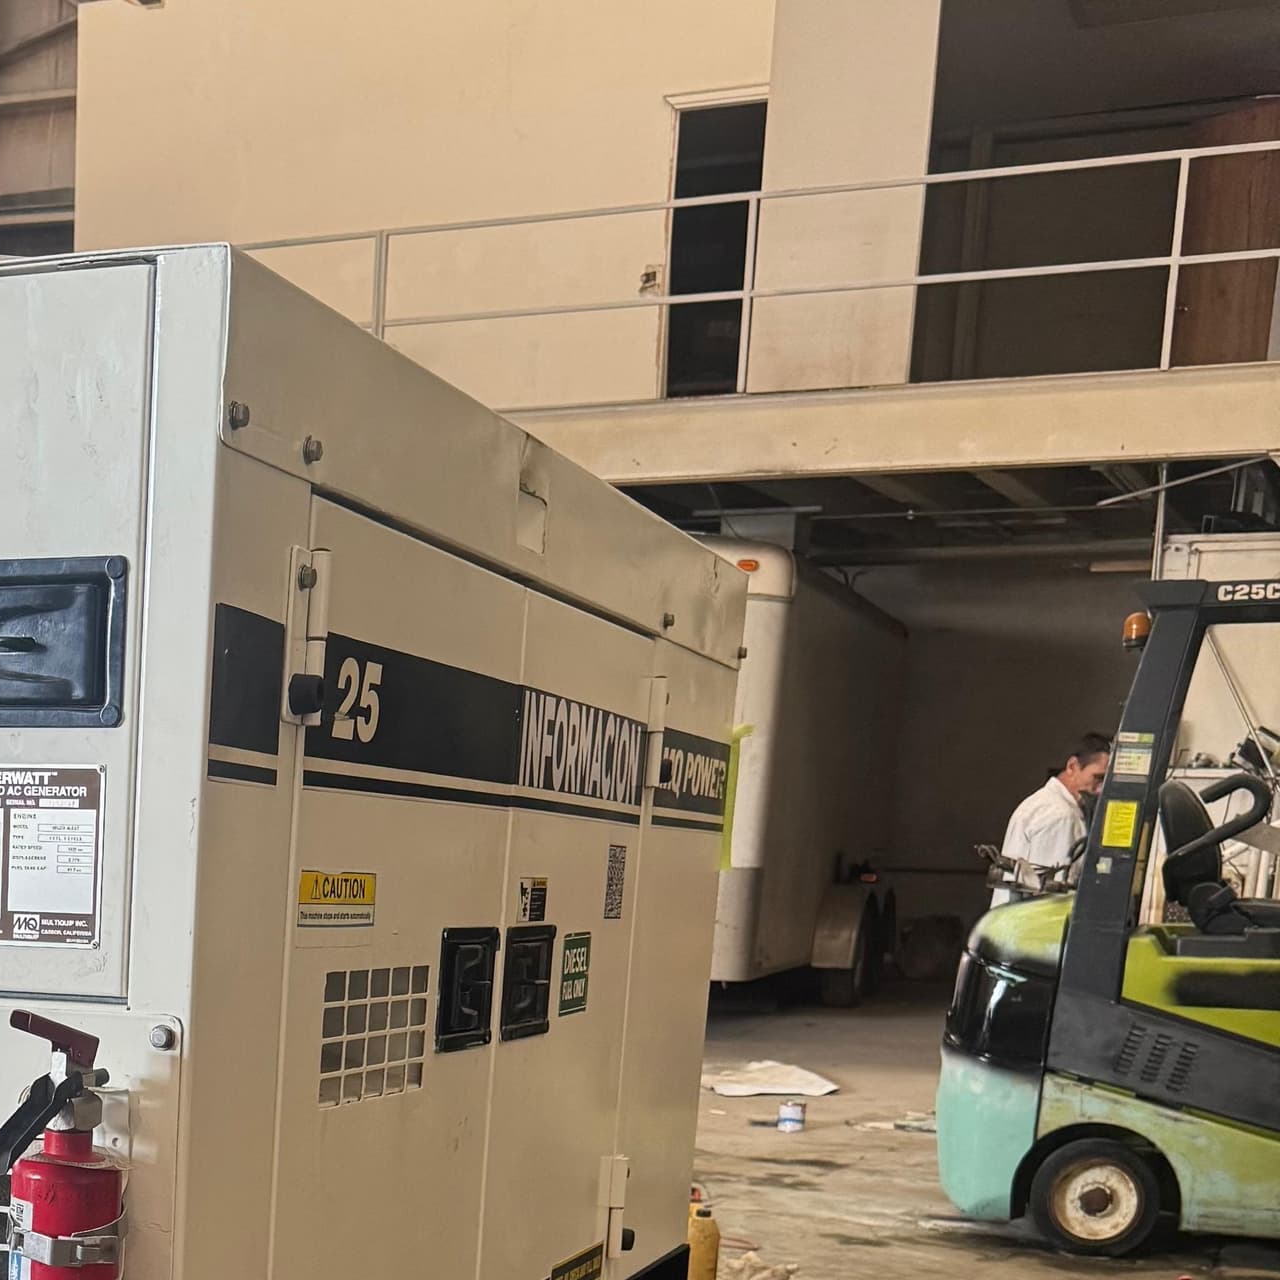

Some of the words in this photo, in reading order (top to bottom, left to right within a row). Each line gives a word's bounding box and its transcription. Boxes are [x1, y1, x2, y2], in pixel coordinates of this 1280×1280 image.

[1218, 583, 1280, 601] C25C
[331, 657, 383, 743] 25
[519, 690, 641, 805] INFORMACION
[7, 785, 22, 796] AC
[24, 786, 87, 797] GENERATOR
[322, 877, 366, 899] CAUTION
[14, 916, 40, 932] MQ
[564, 946, 588, 975] DIESEL
[562, 980, 573, 1001] FUEL
